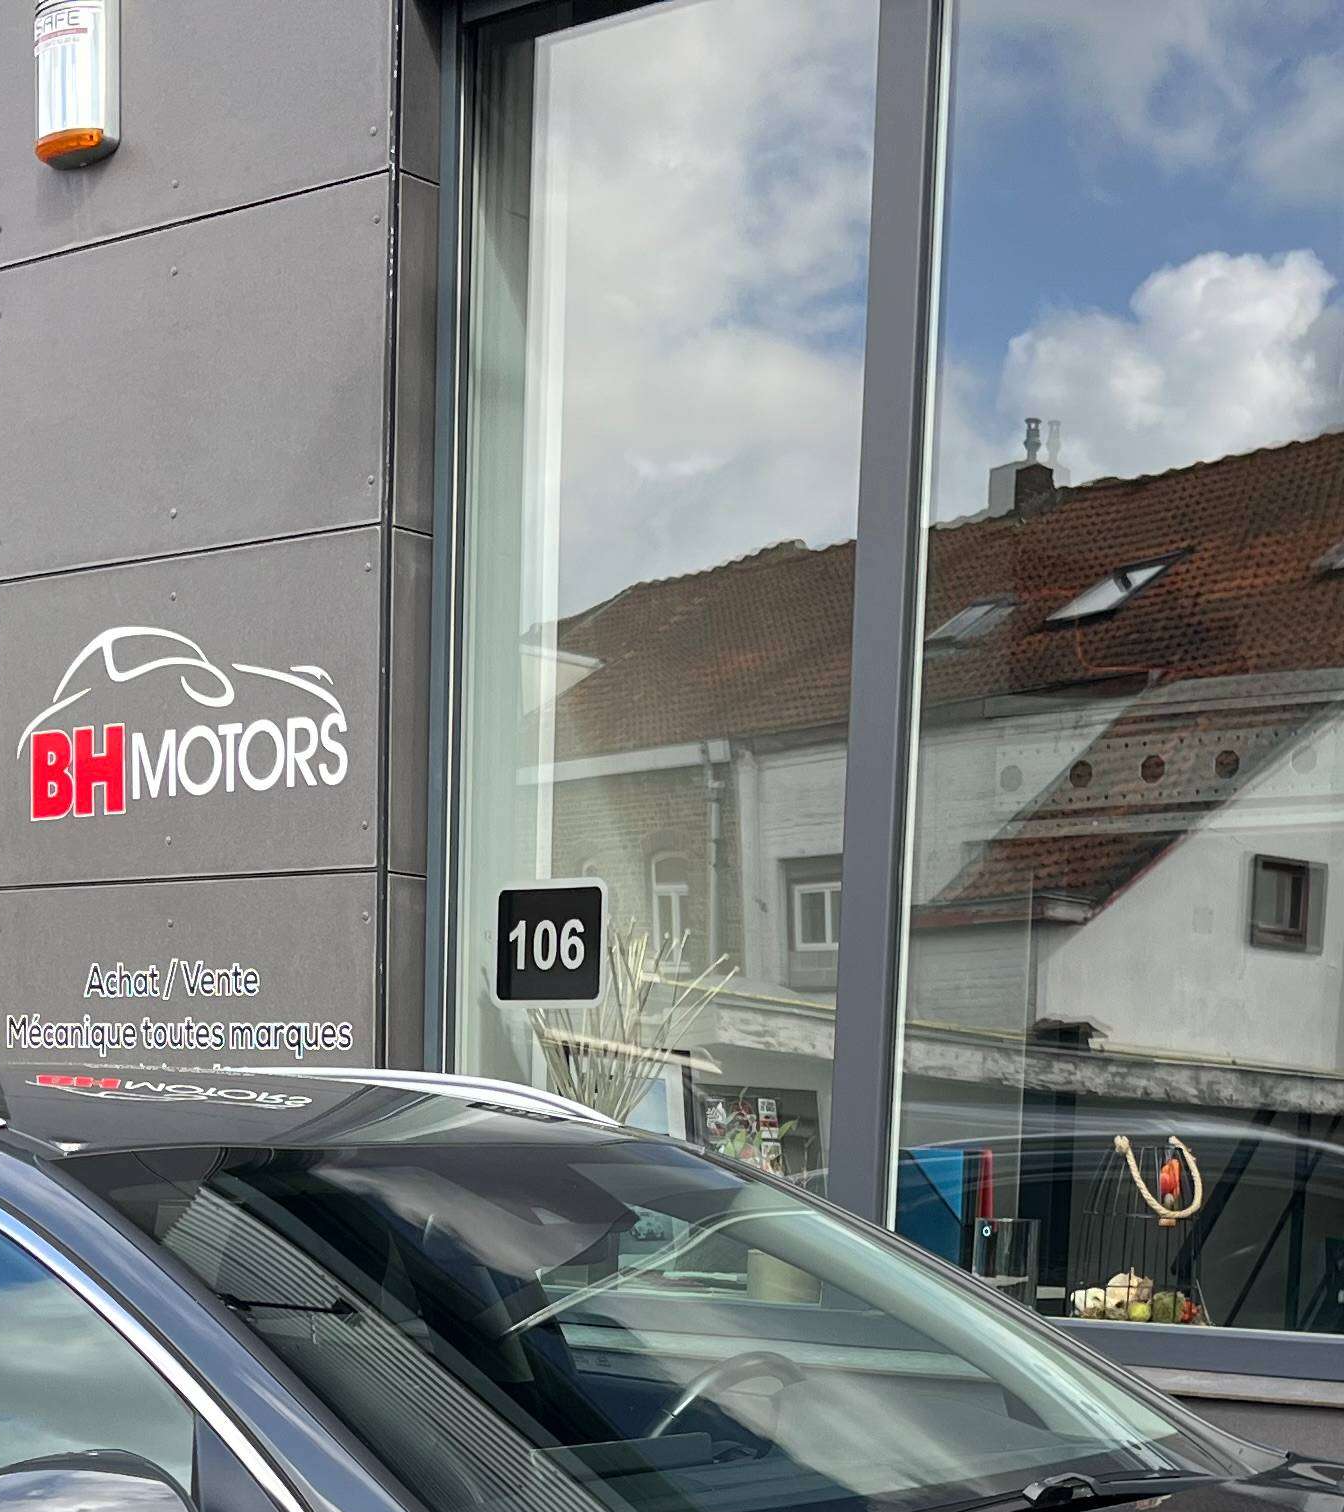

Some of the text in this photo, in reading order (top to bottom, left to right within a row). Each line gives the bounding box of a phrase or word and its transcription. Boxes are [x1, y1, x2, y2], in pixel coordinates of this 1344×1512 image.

[30, 713, 348, 821] BH MOTORS
[508, 920, 586, 970] 106
[84, 962, 160, 998] Achat
[182, 961, 260, 998] Vente
[6, 1014, 353, 1058] Mécanique toutes marques
